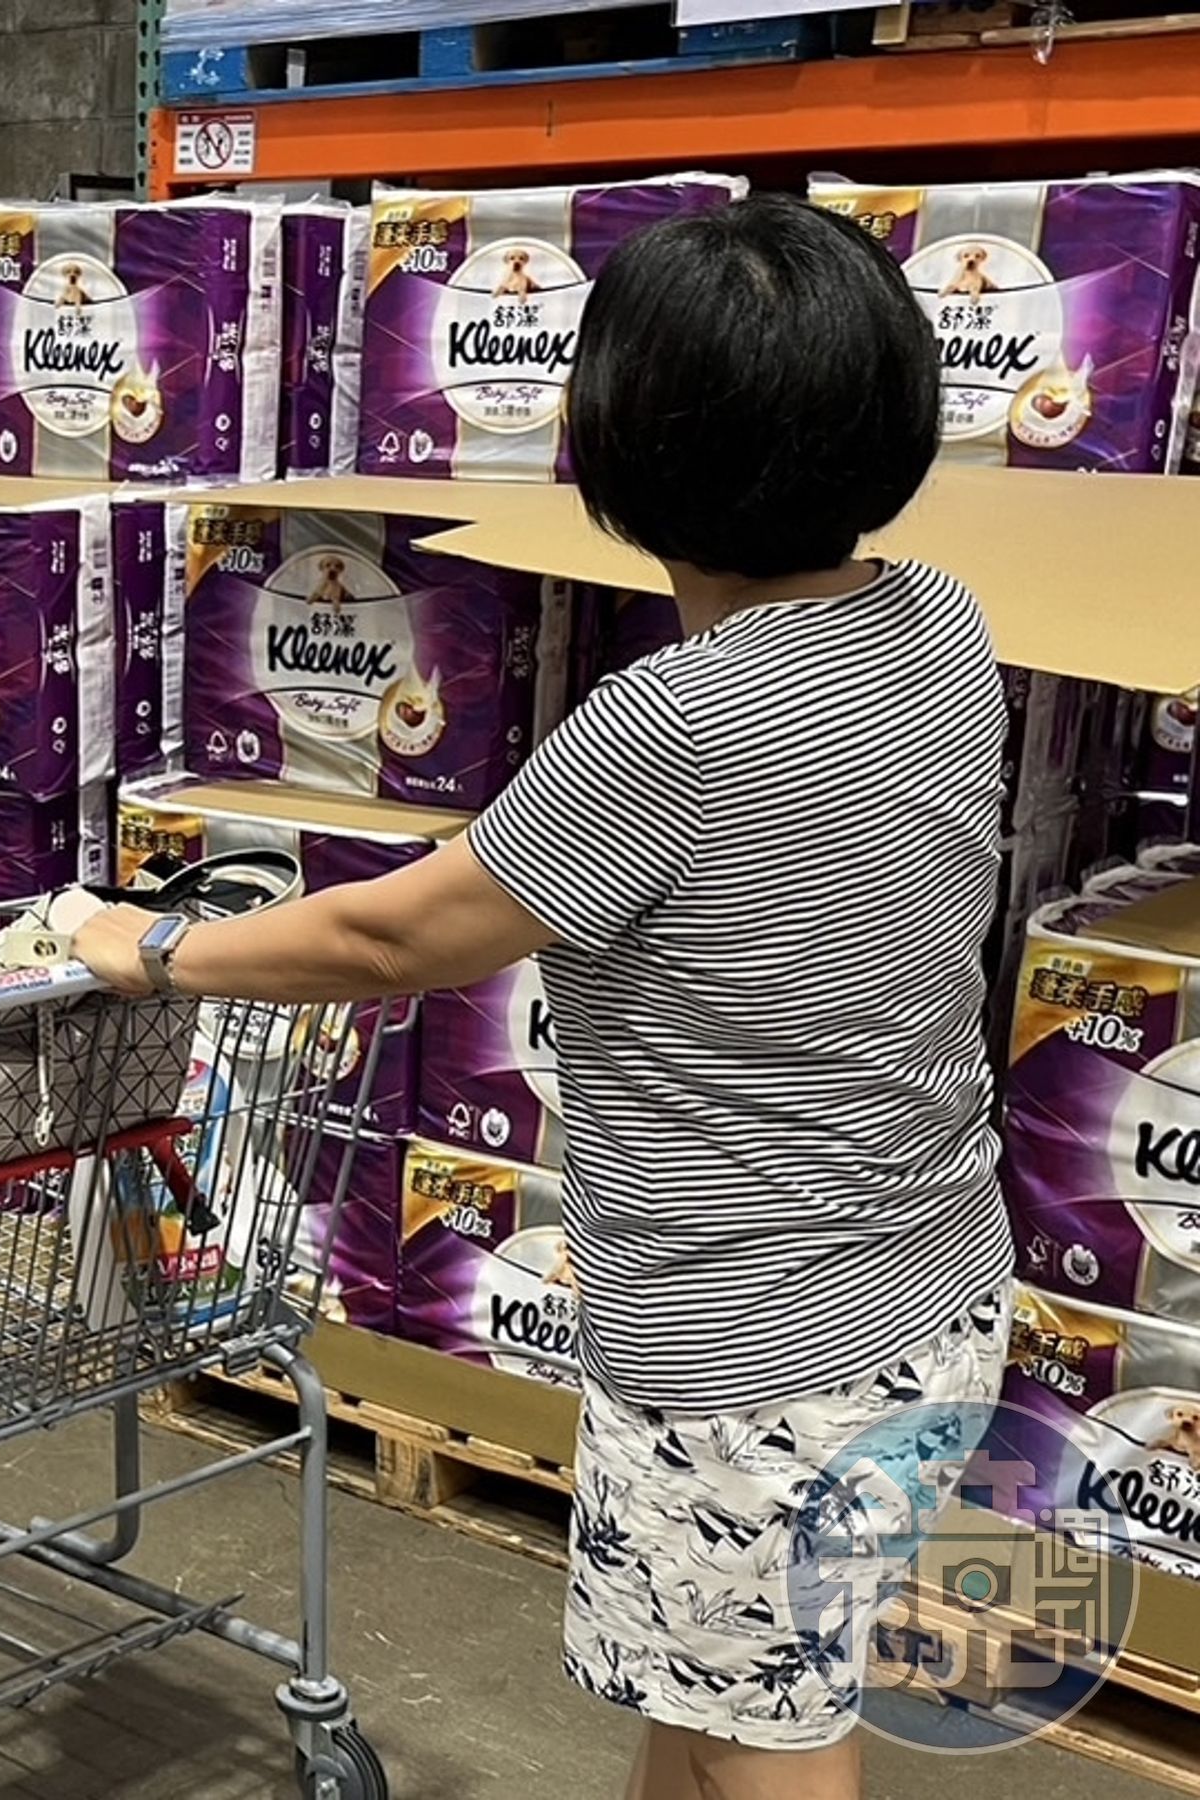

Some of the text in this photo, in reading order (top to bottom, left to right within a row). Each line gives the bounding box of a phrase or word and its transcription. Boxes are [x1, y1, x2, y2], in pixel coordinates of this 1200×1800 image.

[494, 305, 539, 328] 舒潔
[938, 305, 993, 330] 舒潔
[25, 329, 123, 380] Kleenex
[449, 320, 577, 374] Kleenex
[937, 333, 1039, 380] enex
[475, 386, 543, 404] Baby Soft
[310, 612, 356, 638] 舒潔
[268, 624, 396, 686] Kleenex
[293, 692, 361, 715] Baby Soft
[436, 775, 455, 793] 24
[1065, 1013, 1144, 1051] +10%
[490, 1295, 582, 1359] Klee
[1077, 1460, 1200, 1544] Kleen
